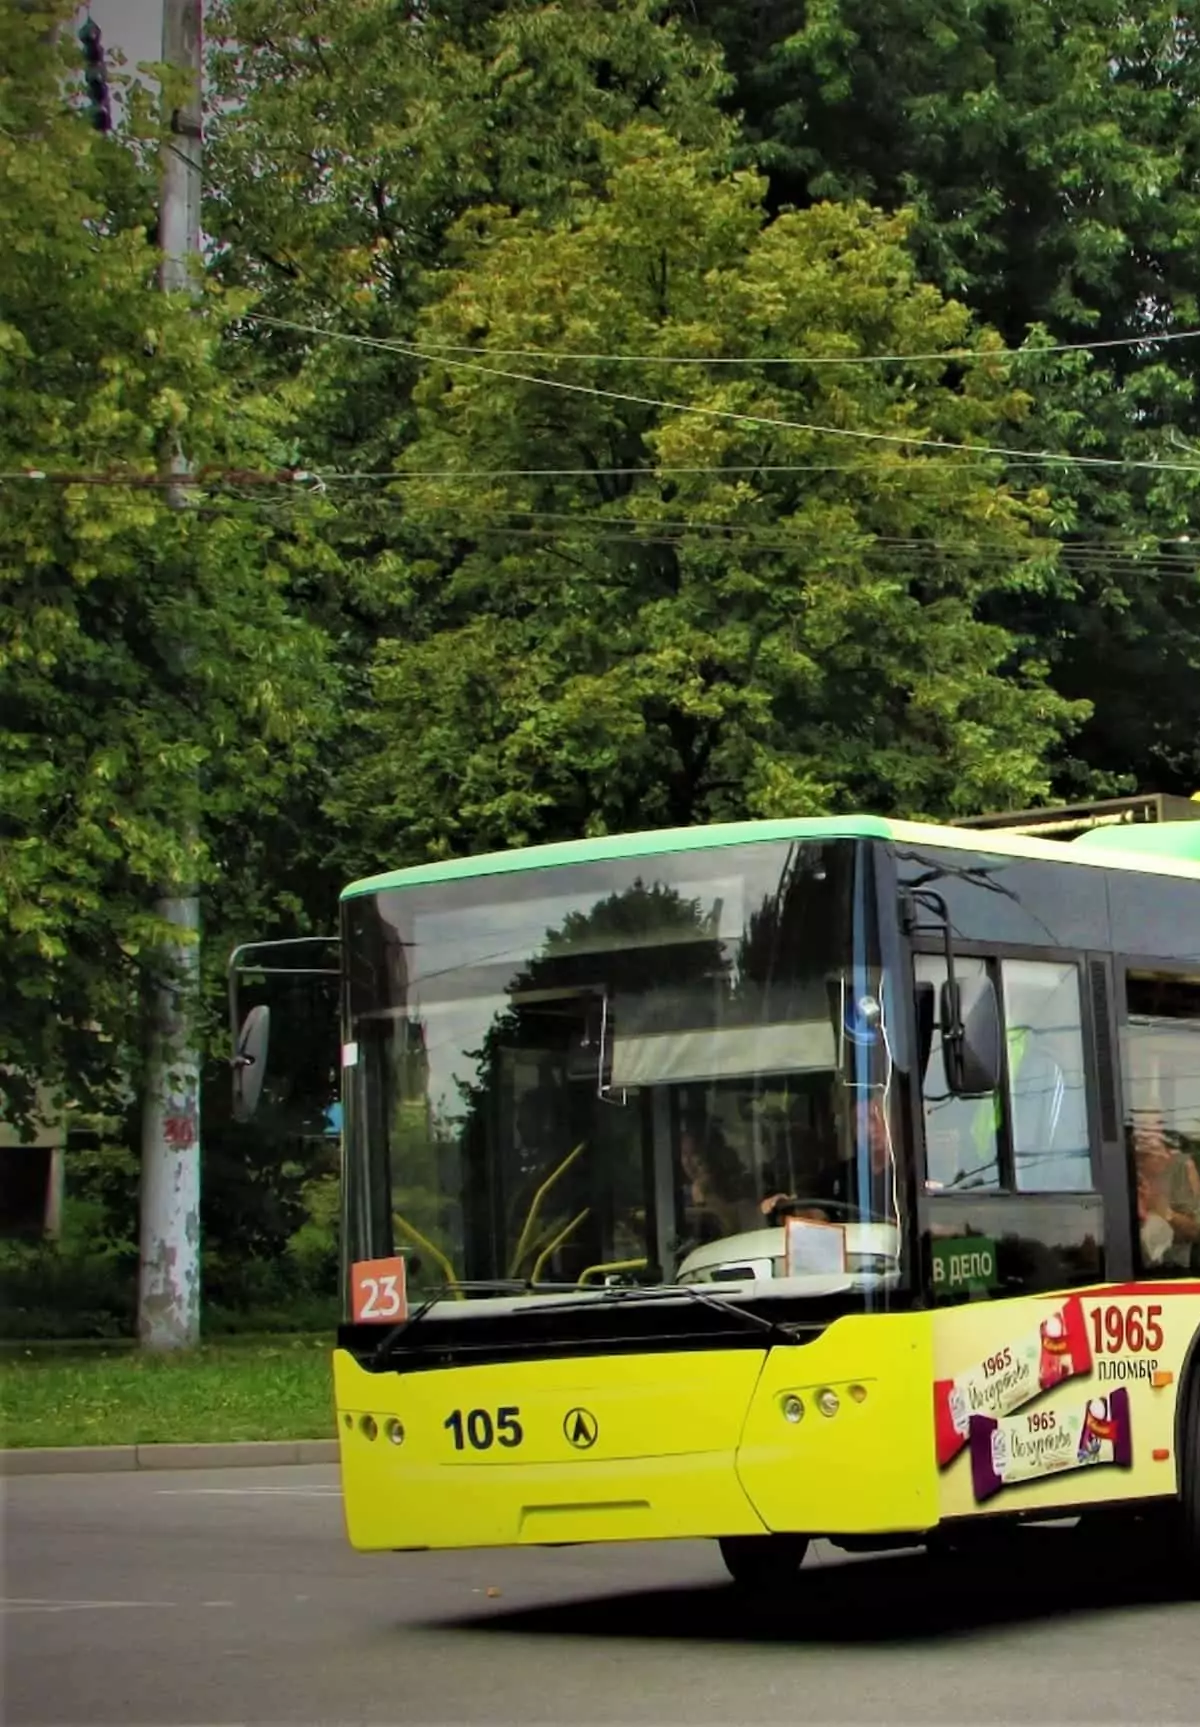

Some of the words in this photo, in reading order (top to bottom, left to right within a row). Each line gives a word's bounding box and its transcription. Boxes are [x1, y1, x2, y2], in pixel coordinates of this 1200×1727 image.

[933, 1257, 945, 1282] В
[949, 1251, 992, 1286] ДЕПО
[360, 1276, 400, 1318] 23
[1090, 1305, 1164, 1354] 1965
[982, 1347, 1012, 1379] 1965
[444, 1406, 523, 1450] 105
[1027, 1411, 1056, 1432] 1965
